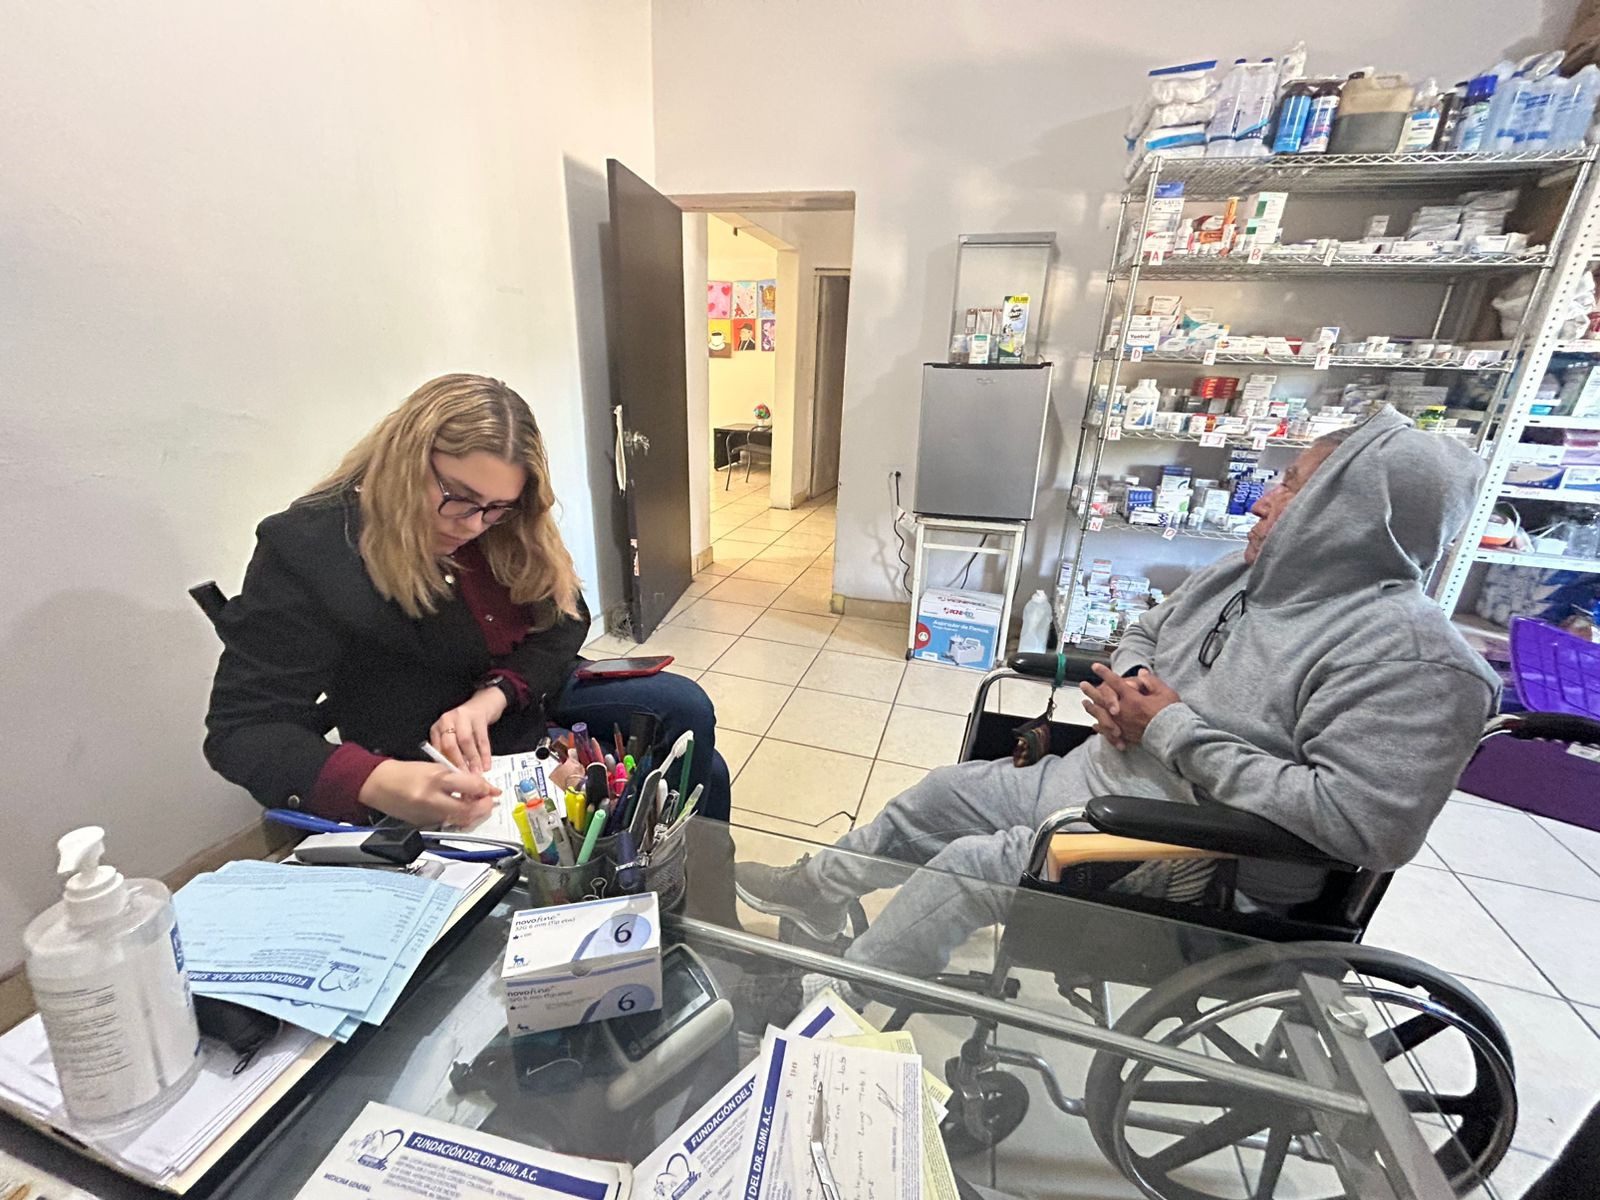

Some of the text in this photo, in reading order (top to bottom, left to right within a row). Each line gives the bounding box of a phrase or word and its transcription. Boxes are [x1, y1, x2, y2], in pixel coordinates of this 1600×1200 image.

[614, 921, 632, 944] 6
[617, 991, 636, 1012] 6
[690, 1100, 737, 1148] FUNDACIÓN
[734, 1087, 753, 1108] DEL
[411, 1136, 466, 1160] FUNDACIÓN
[462, 1149, 481, 1165] DEL
[480, 1155, 497, 1170] DR.
[496, 1159, 520, 1176] SIMI,
[519, 1167, 538, 1182] A.C.
[748, 1106, 773, 1197] DEL DR. SIMI, A.C.
